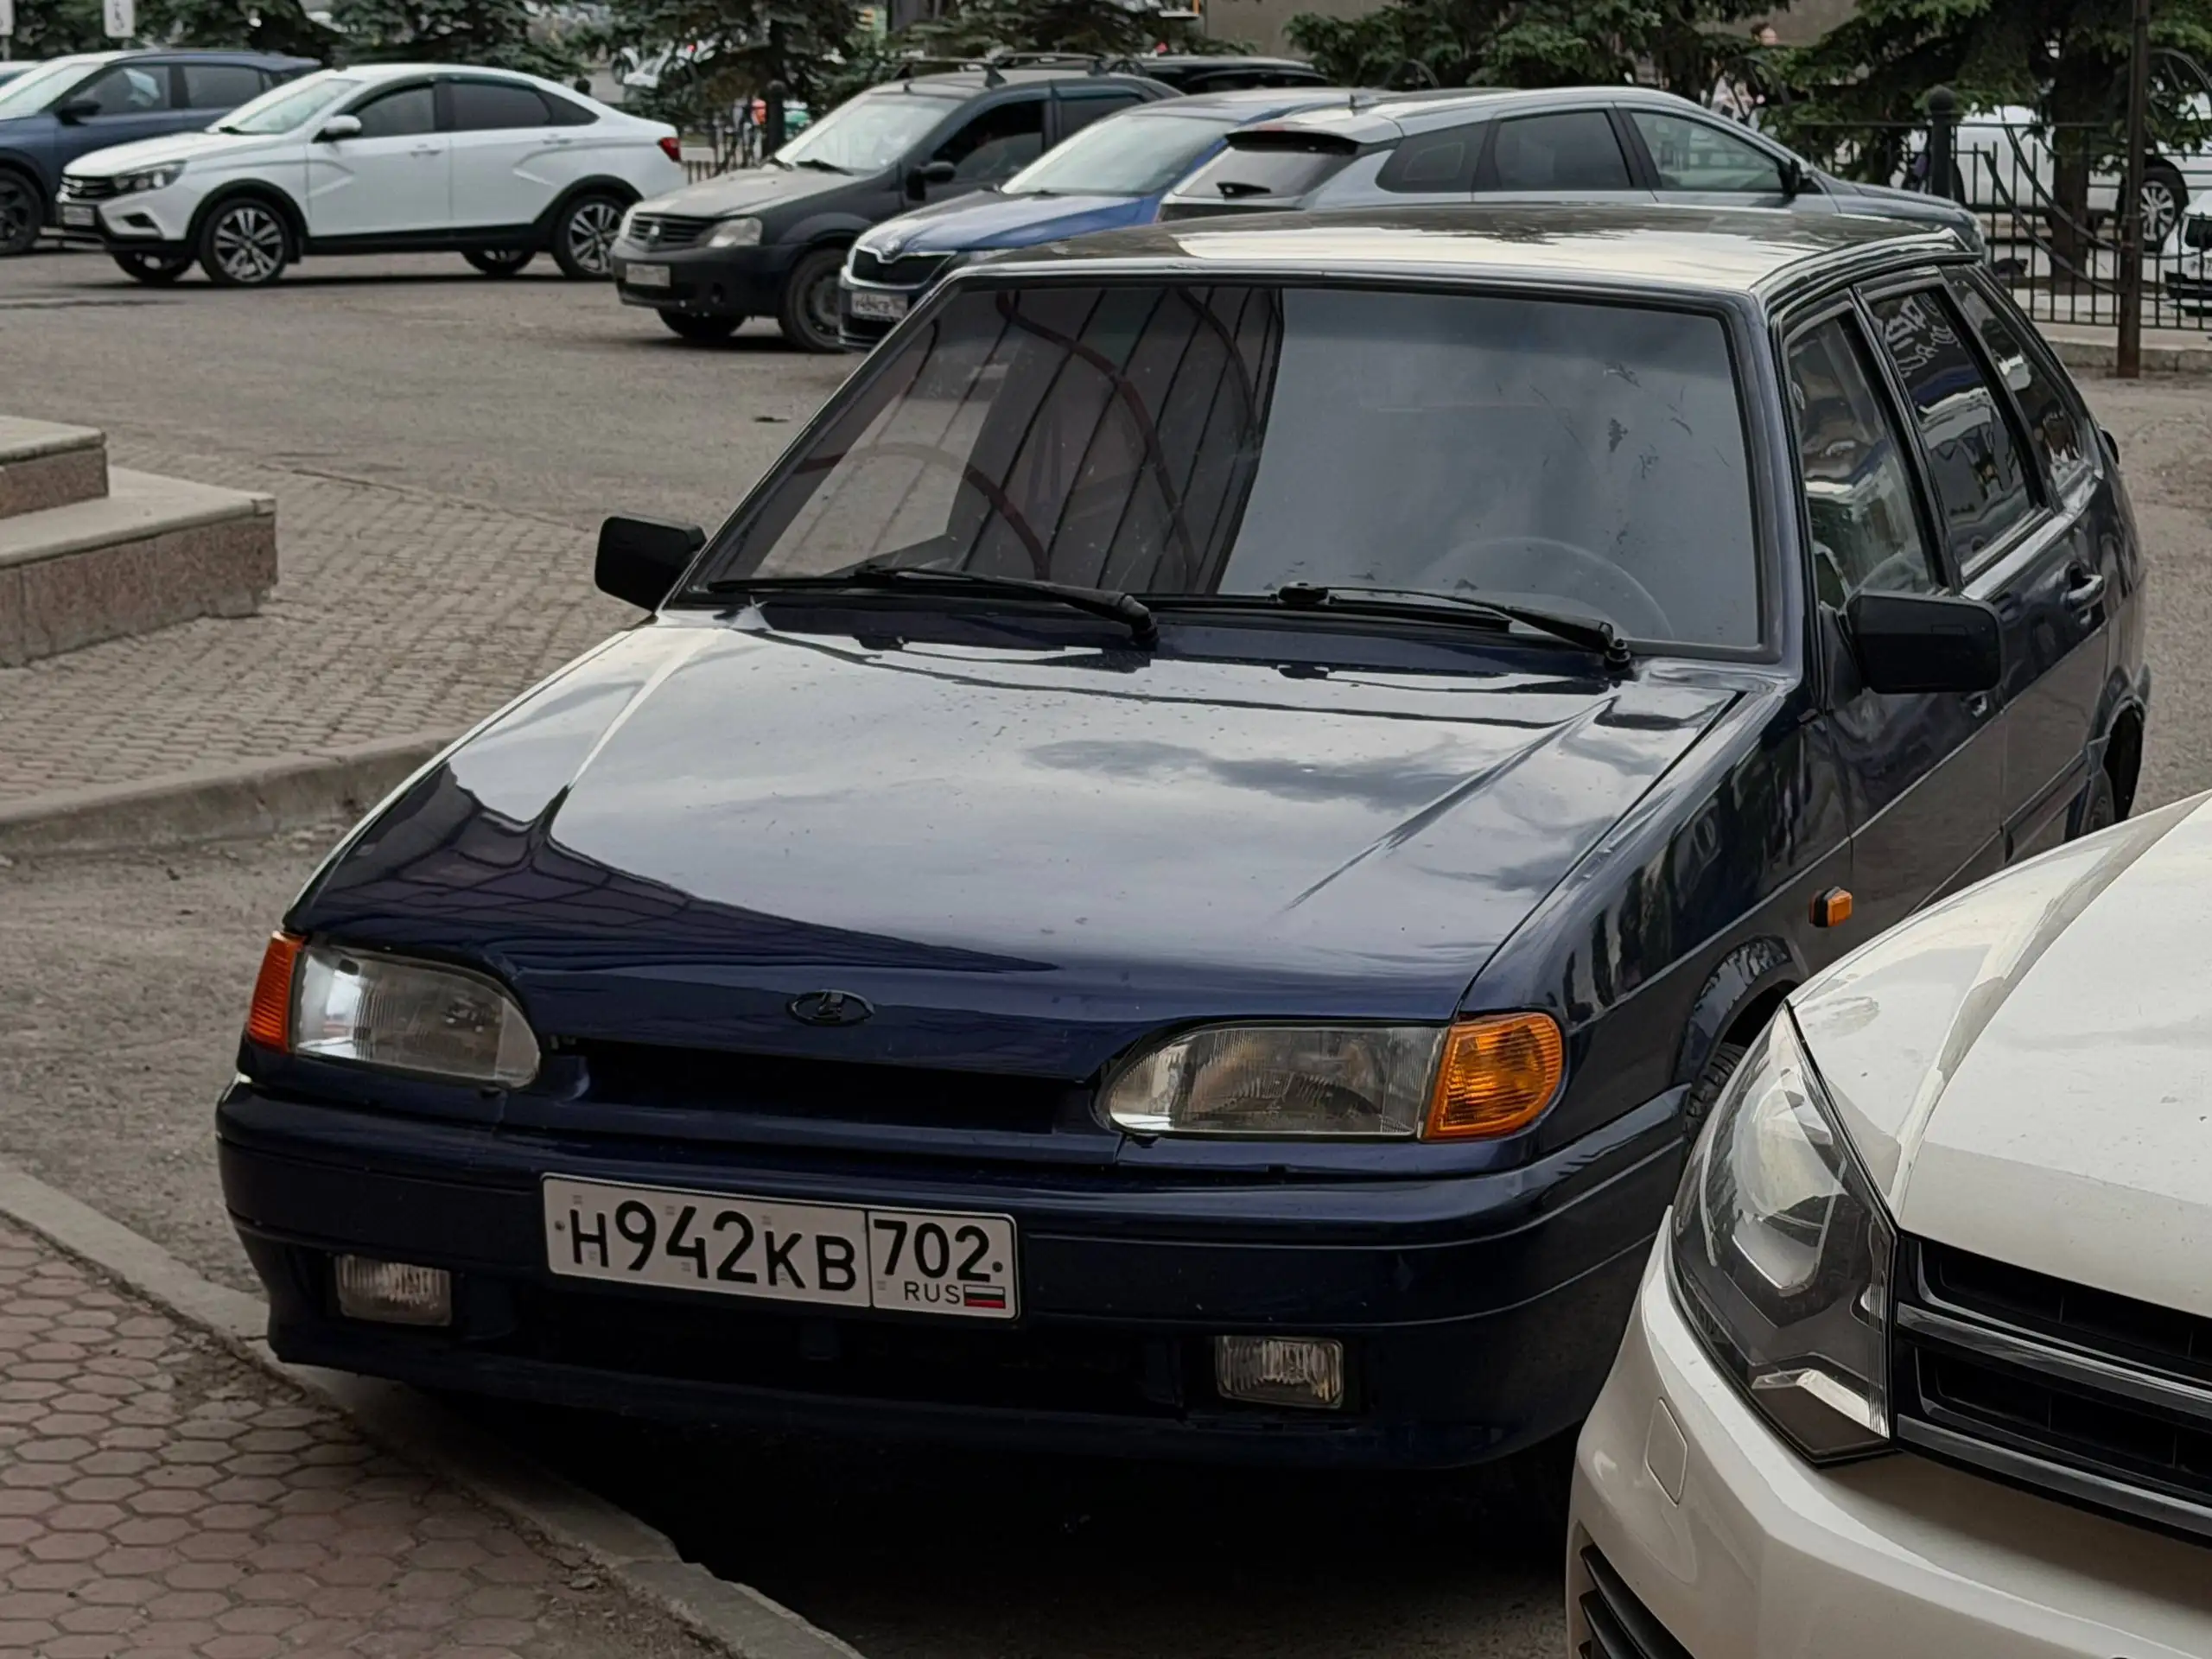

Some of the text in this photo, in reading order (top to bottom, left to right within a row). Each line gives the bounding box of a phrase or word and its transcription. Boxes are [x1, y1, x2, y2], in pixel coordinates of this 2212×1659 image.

[569, 1200, 990, 1292] Н942КВ 702
[904, 1281, 960, 1304] RUS
